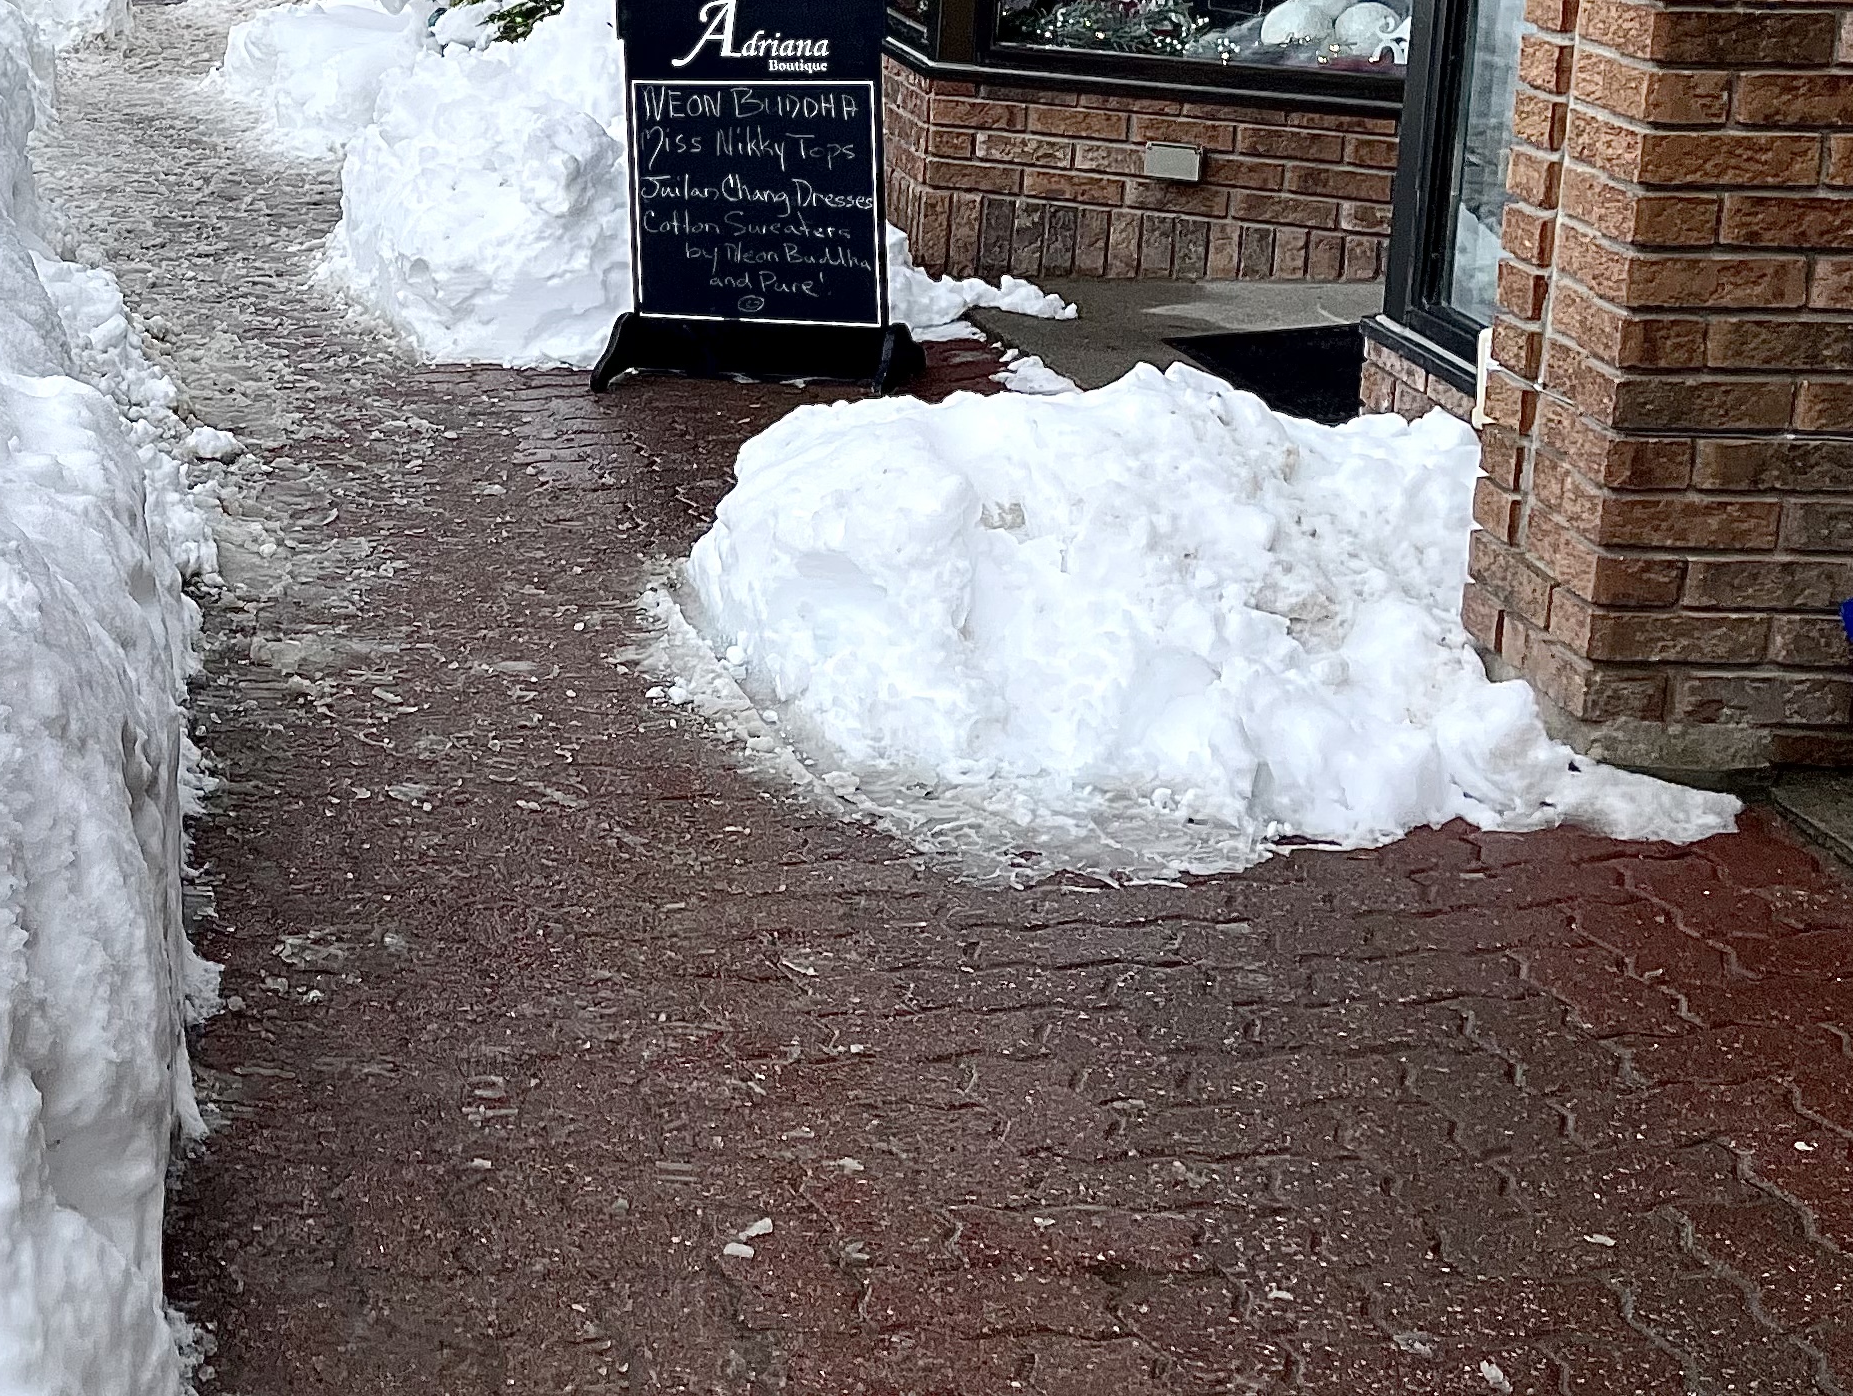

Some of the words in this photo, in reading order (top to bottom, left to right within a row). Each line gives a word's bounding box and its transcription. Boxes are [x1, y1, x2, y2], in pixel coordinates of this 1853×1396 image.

[768, 59, 828, 72] Boutique
[641, 85, 722, 122] NEON
[716, 124, 785, 172] Nikky
[785, 132, 856, 171] Tops
[792, 178, 874, 210] Dresses
[643, 209, 720, 236] Cotton
[724, 210, 851, 239] Sweaters
[685, 242, 718, 275] by
[709, 271, 753, 289] and
